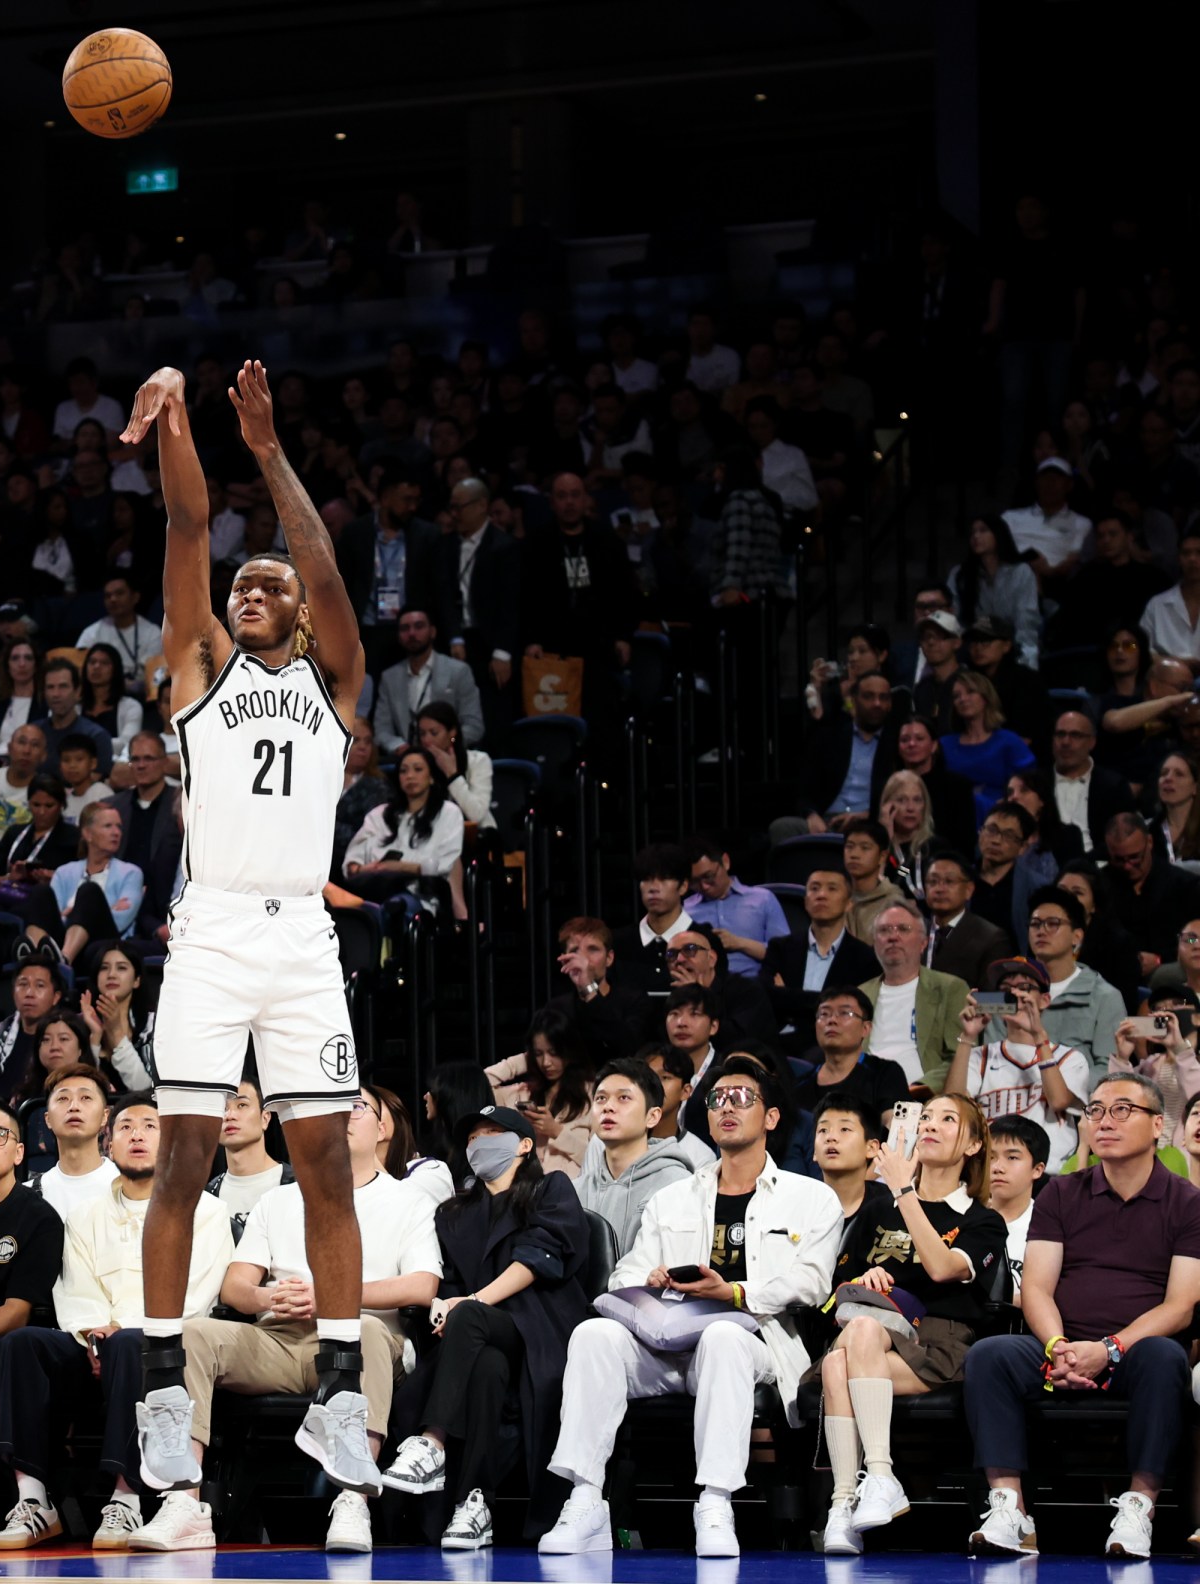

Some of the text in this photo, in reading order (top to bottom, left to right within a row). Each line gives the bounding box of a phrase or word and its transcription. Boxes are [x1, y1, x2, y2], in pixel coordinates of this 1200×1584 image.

[218, 688, 324, 736] BROOKLYN
[252, 739, 293, 796] 21
[336, 1041, 349, 1076] B
